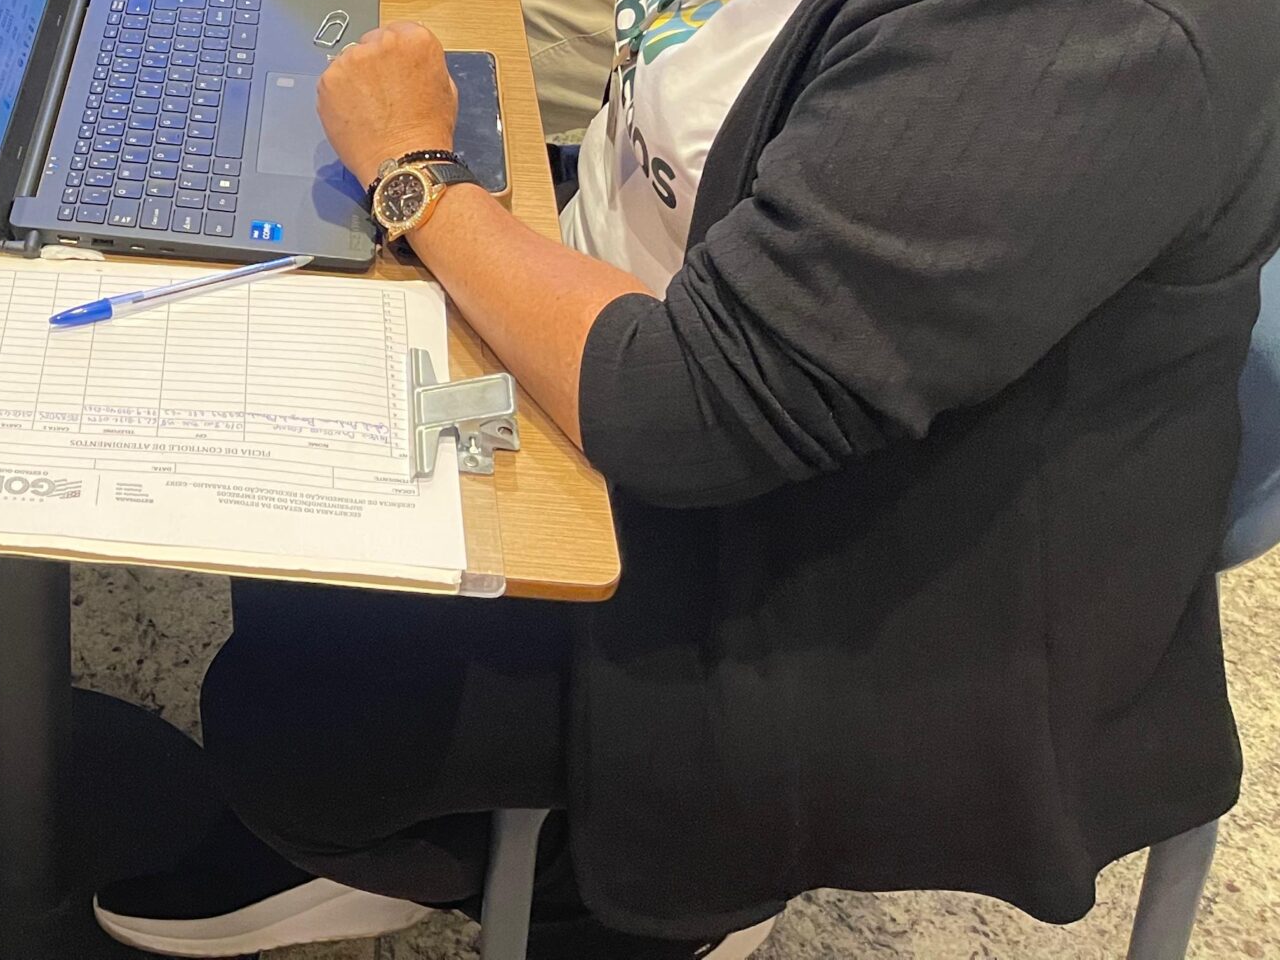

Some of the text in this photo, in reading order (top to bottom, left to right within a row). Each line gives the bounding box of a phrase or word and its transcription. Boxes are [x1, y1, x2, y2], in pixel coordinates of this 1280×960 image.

[70, 440, 150, 450] ATENDIMENTOS
[169, 444, 223, 454] CONTROLE
[242, 449, 270, 458] FICHA
[193, 483, 231, 491] TRABALHO
[217, 491, 255, 500] EMPREGOS
[245, 486, 297, 499] RECOLOCAÇÃO
[218, 498, 259, 507] RETOMADA
[290, 499, 363, 511] SUPERINTENDÊNCIA
[274, 504, 302, 513] ESTADO
[316, 509, 361, 518] SECRETARIA
